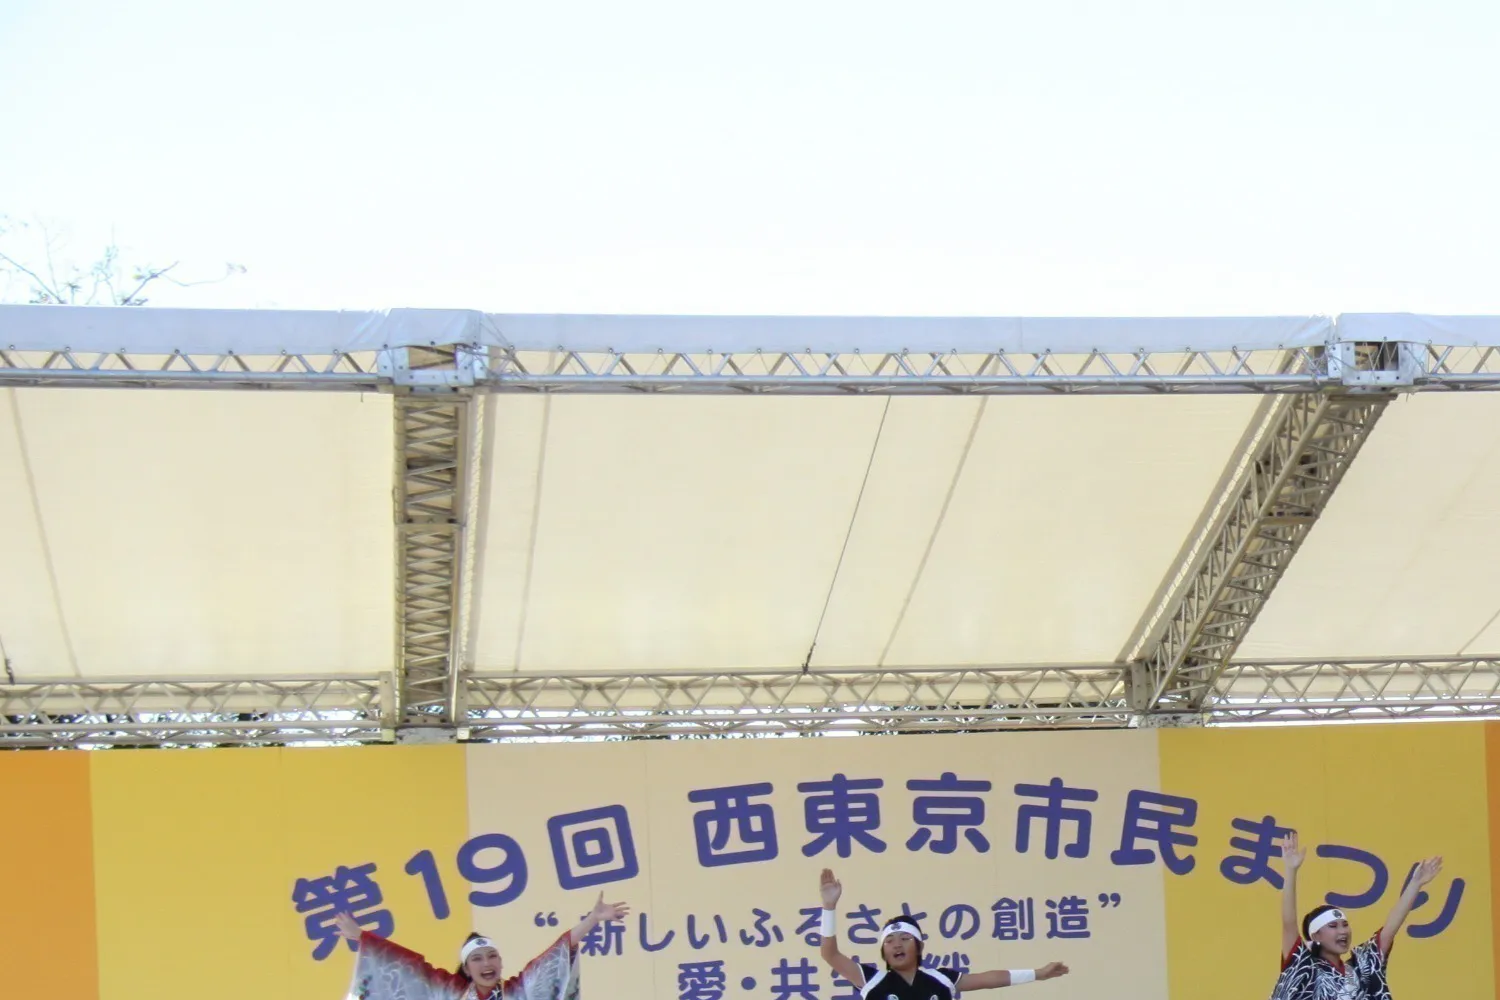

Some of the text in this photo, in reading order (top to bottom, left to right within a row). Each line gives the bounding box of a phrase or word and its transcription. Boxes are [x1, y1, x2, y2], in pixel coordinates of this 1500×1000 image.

[291, 771, 1466, 961] 第19回 西東京市民まつり
